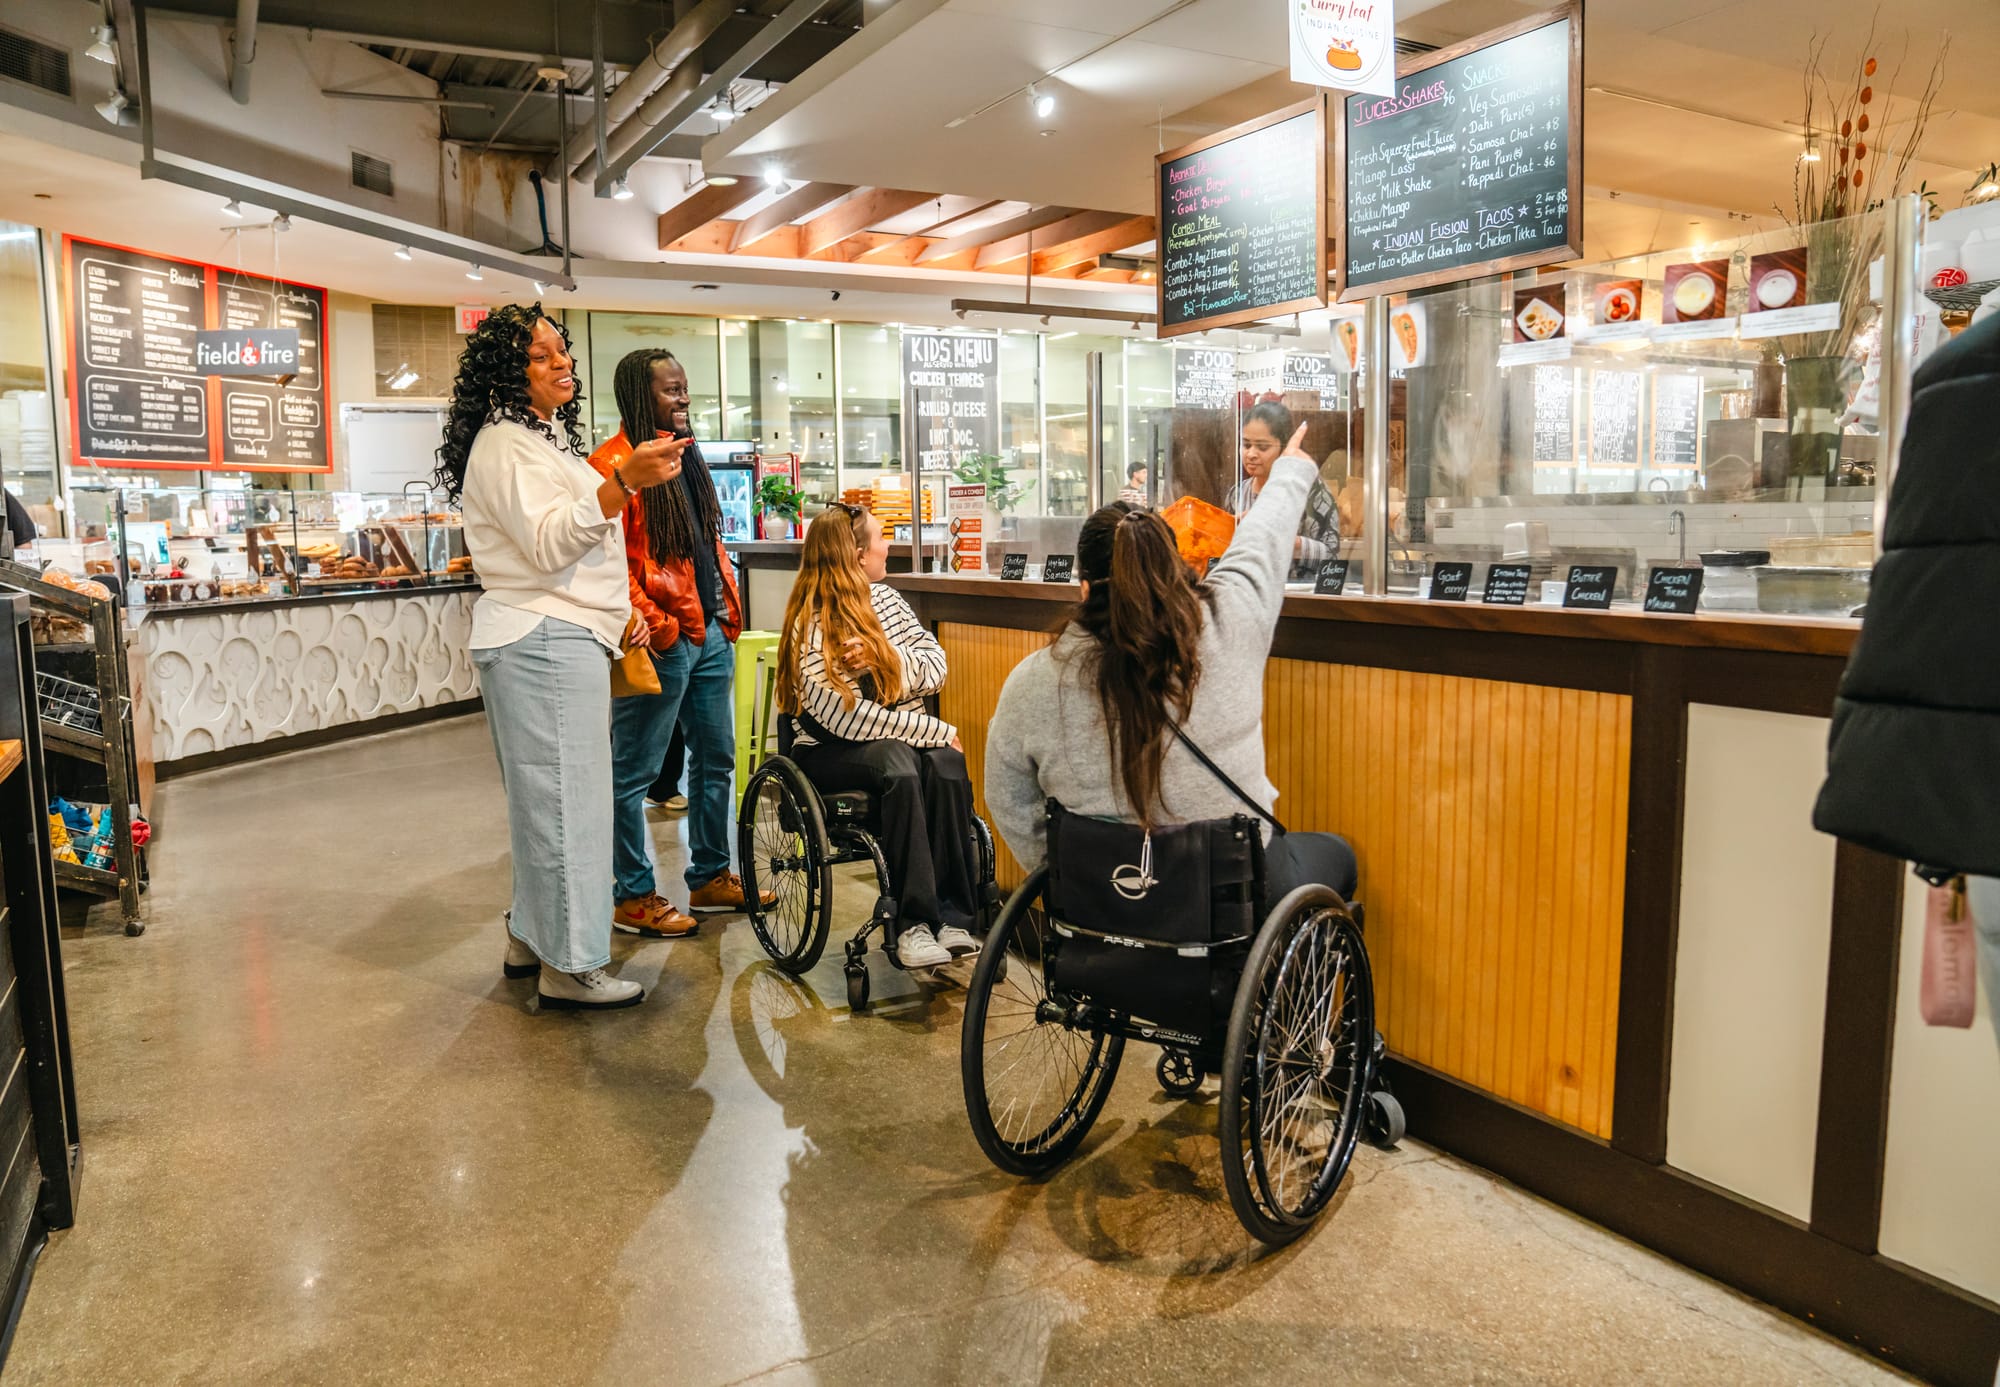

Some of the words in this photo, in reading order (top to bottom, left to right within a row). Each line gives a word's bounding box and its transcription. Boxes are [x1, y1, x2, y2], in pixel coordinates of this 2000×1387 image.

[1348, 0, 1373, 22] leaf
[1306, 17, 1339, 32] INDIAN
[1344, 25, 1379, 40] CUISINE
[1469, 94, 1488, 117] Veg
[1468, 118, 1493, 134] Dahi
[1467, 137, 1506, 153] Samosa
[1510, 123, 1534, 143] Chat
[1355, 145, 1377, 167] Fresh
[1411, 131, 1430, 151] Fruit
[1432, 130, 1454, 147] Juice
[1470, 155, 1490, 171] Pani
[1509, 157, 1534, 177] Chat
[1354, 169, 1386, 187] Mango
[1391, 162, 1416, 177] Lassi
[1175, 185, 1202, 202] Chicken
[1355, 191, 1377, 206] Rose
[1381, 180, 1402, 201] Milk
[1404, 175, 1432, 195] Shake
[1535, 193, 1542, 204] 2
[1177, 199, 1198, 216] Goat
[1535, 208, 1543, 219] 3
[1171, 222, 1195, 238] COMBO
[1198, 213, 1221, 230] MEAL
[1252, 224, 1274, 237] Chicken
[1383, 229, 1424, 250] INDIAN
[1430, 218, 1469, 238] FUSION
[1475, 206, 1514, 228] TACOS
[1252, 236, 1274, 250] Butter
[1278, 229, 1303, 243] Chicken
[1352, 259, 1376, 275] Paneer
[1377, 254, 1395, 270] Taco
[1401, 250, 1425, 267] Butter
[1453, 238, 1472, 254] Taco
[1480, 231, 1511, 250] Chicken
[1513, 224, 1536, 242] Tikka
[1541, 219, 1563, 236] Taco
[1274, 244, 1296, 256] Curry
[1253, 260, 1278, 273] Chicken
[1280, 256, 1301, 268] Curry
[196, 340, 294, 365] field&fire
[911, 337, 950, 363] KIDS
[954, 339, 993, 364] MENU
[1194, 351, 1234, 368] FOOD
[1285, 357, 1321, 374] FOOD
[910, 371, 945, 386] CHICKEN
[948, 372, 985, 388] TENDERS
[952, 401, 987, 417] CHEESE
[953, 428, 973, 446] DOG
[1045, 569, 1071, 580] Samosa
[1321, 561, 1345, 575] Chicken
[1571, 568, 1602, 583] BUTTER
[1438, 570, 1463, 585] Goat
[1653, 571, 1692, 585] CHICKEN
[1571, 587, 1607, 602] CHICKEN
[1663, 585, 1689, 597] TIKKA
